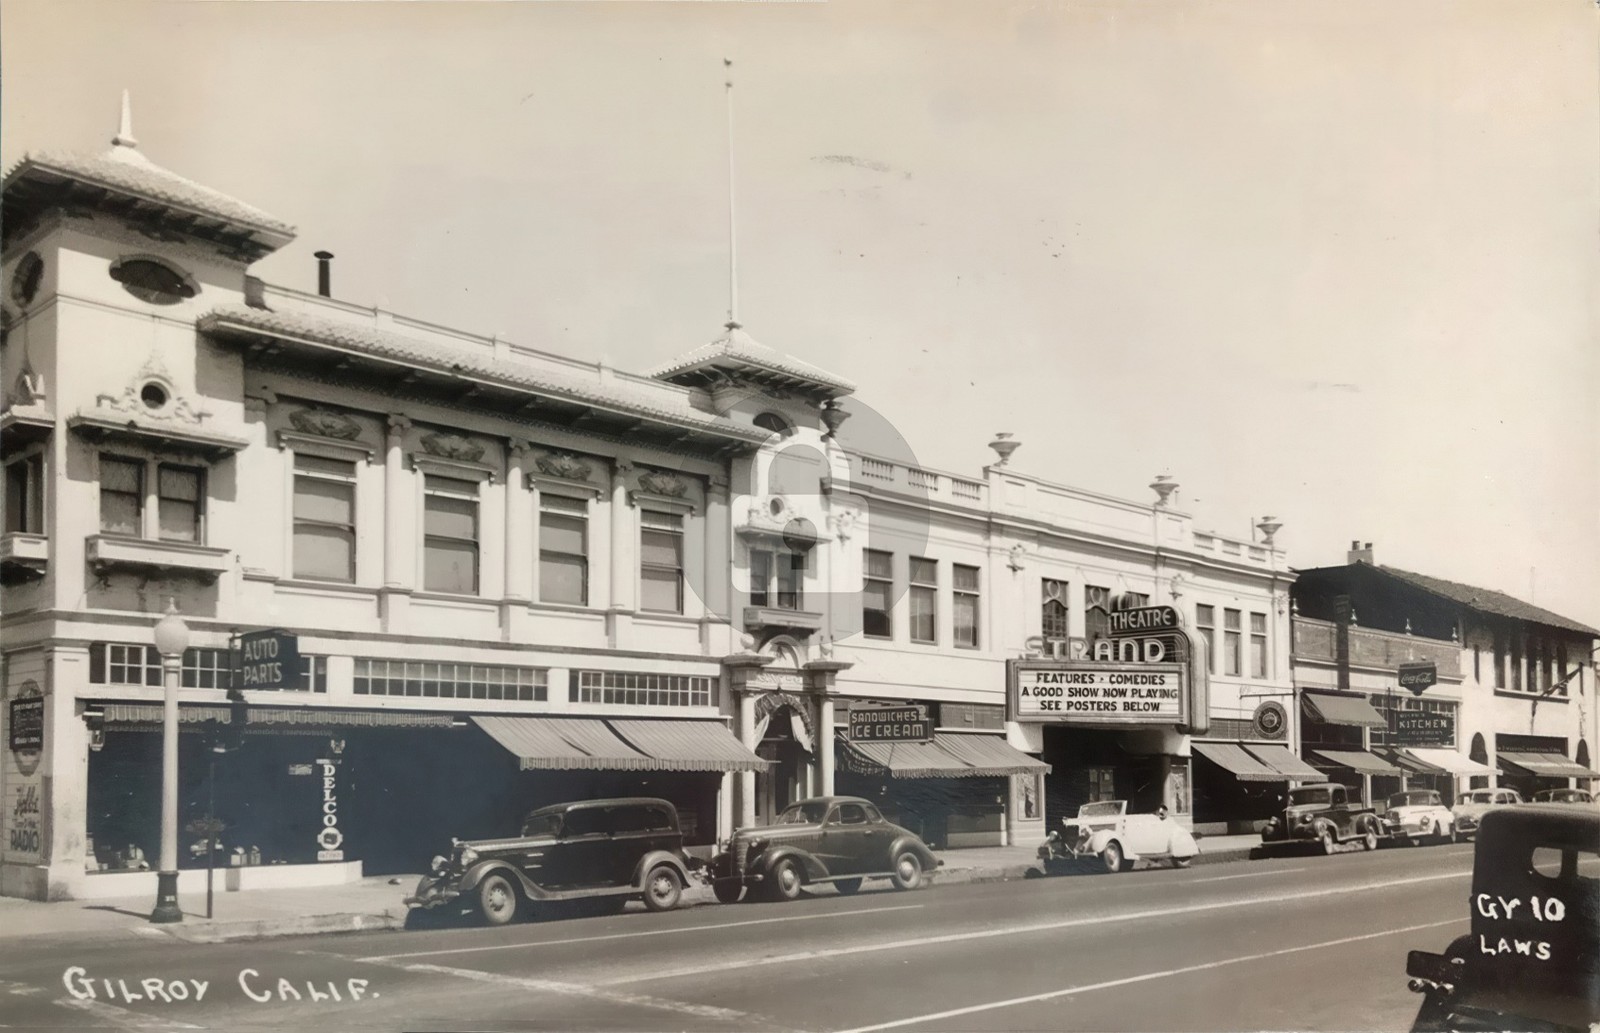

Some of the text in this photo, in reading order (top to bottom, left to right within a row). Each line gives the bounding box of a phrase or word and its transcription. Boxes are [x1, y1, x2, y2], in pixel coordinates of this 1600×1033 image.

[1111, 608, 1172, 629] THEATRE
[244, 637, 279, 661] AUTO
[1021, 635, 1166, 662] STRAND
[243, 662, 283, 686] PARTS
[1036, 672, 1166, 685] FEATURES COMEDIES
[1021, 686, 1178, 699] A GOOD SHOW NOW PLAYING
[1040, 700, 1161, 712] SEE POSTERS BELOW
[851, 710, 918, 724] SANDWICHES
[1399, 719, 1447, 729] KITCHEN
[851, 723, 924, 738] ICE CREAM
[322, 764, 338, 827] DELCO
